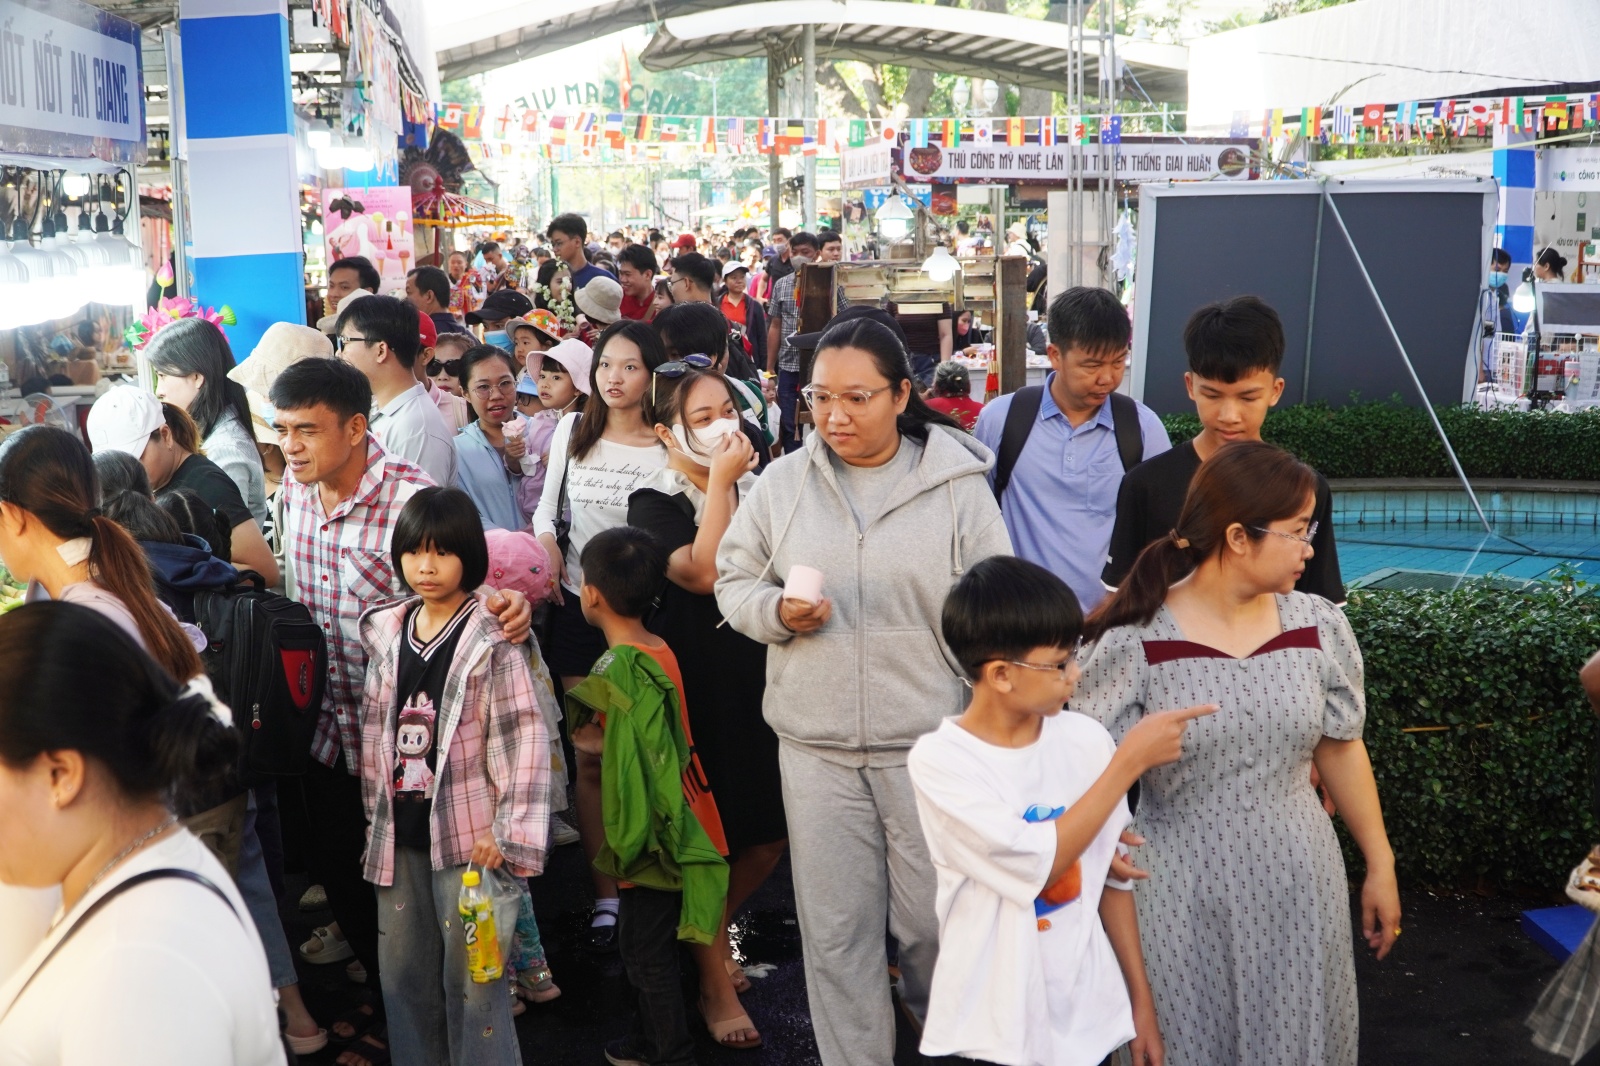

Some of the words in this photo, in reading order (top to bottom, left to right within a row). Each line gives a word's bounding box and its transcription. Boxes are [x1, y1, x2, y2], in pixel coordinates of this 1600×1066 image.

[33, 29, 63, 114] NỐT
[71, 50, 89, 119] AN
[93, 57, 129, 124] GIANG
[948, 149, 966, 169] THỦ
[970, 151, 995, 170] CÔNG
[999, 151, 1014, 170] MỸ
[1018, 151, 1042, 173] NGHỆ
[1046, 151, 1064, 171] LÂN
[1131, 150, 1161, 172] THỐNG
[1165, 155, 1183, 172] GIAI
[1578, 169, 1596, 180] CÔNG
[606, 480, 622, 496] why
